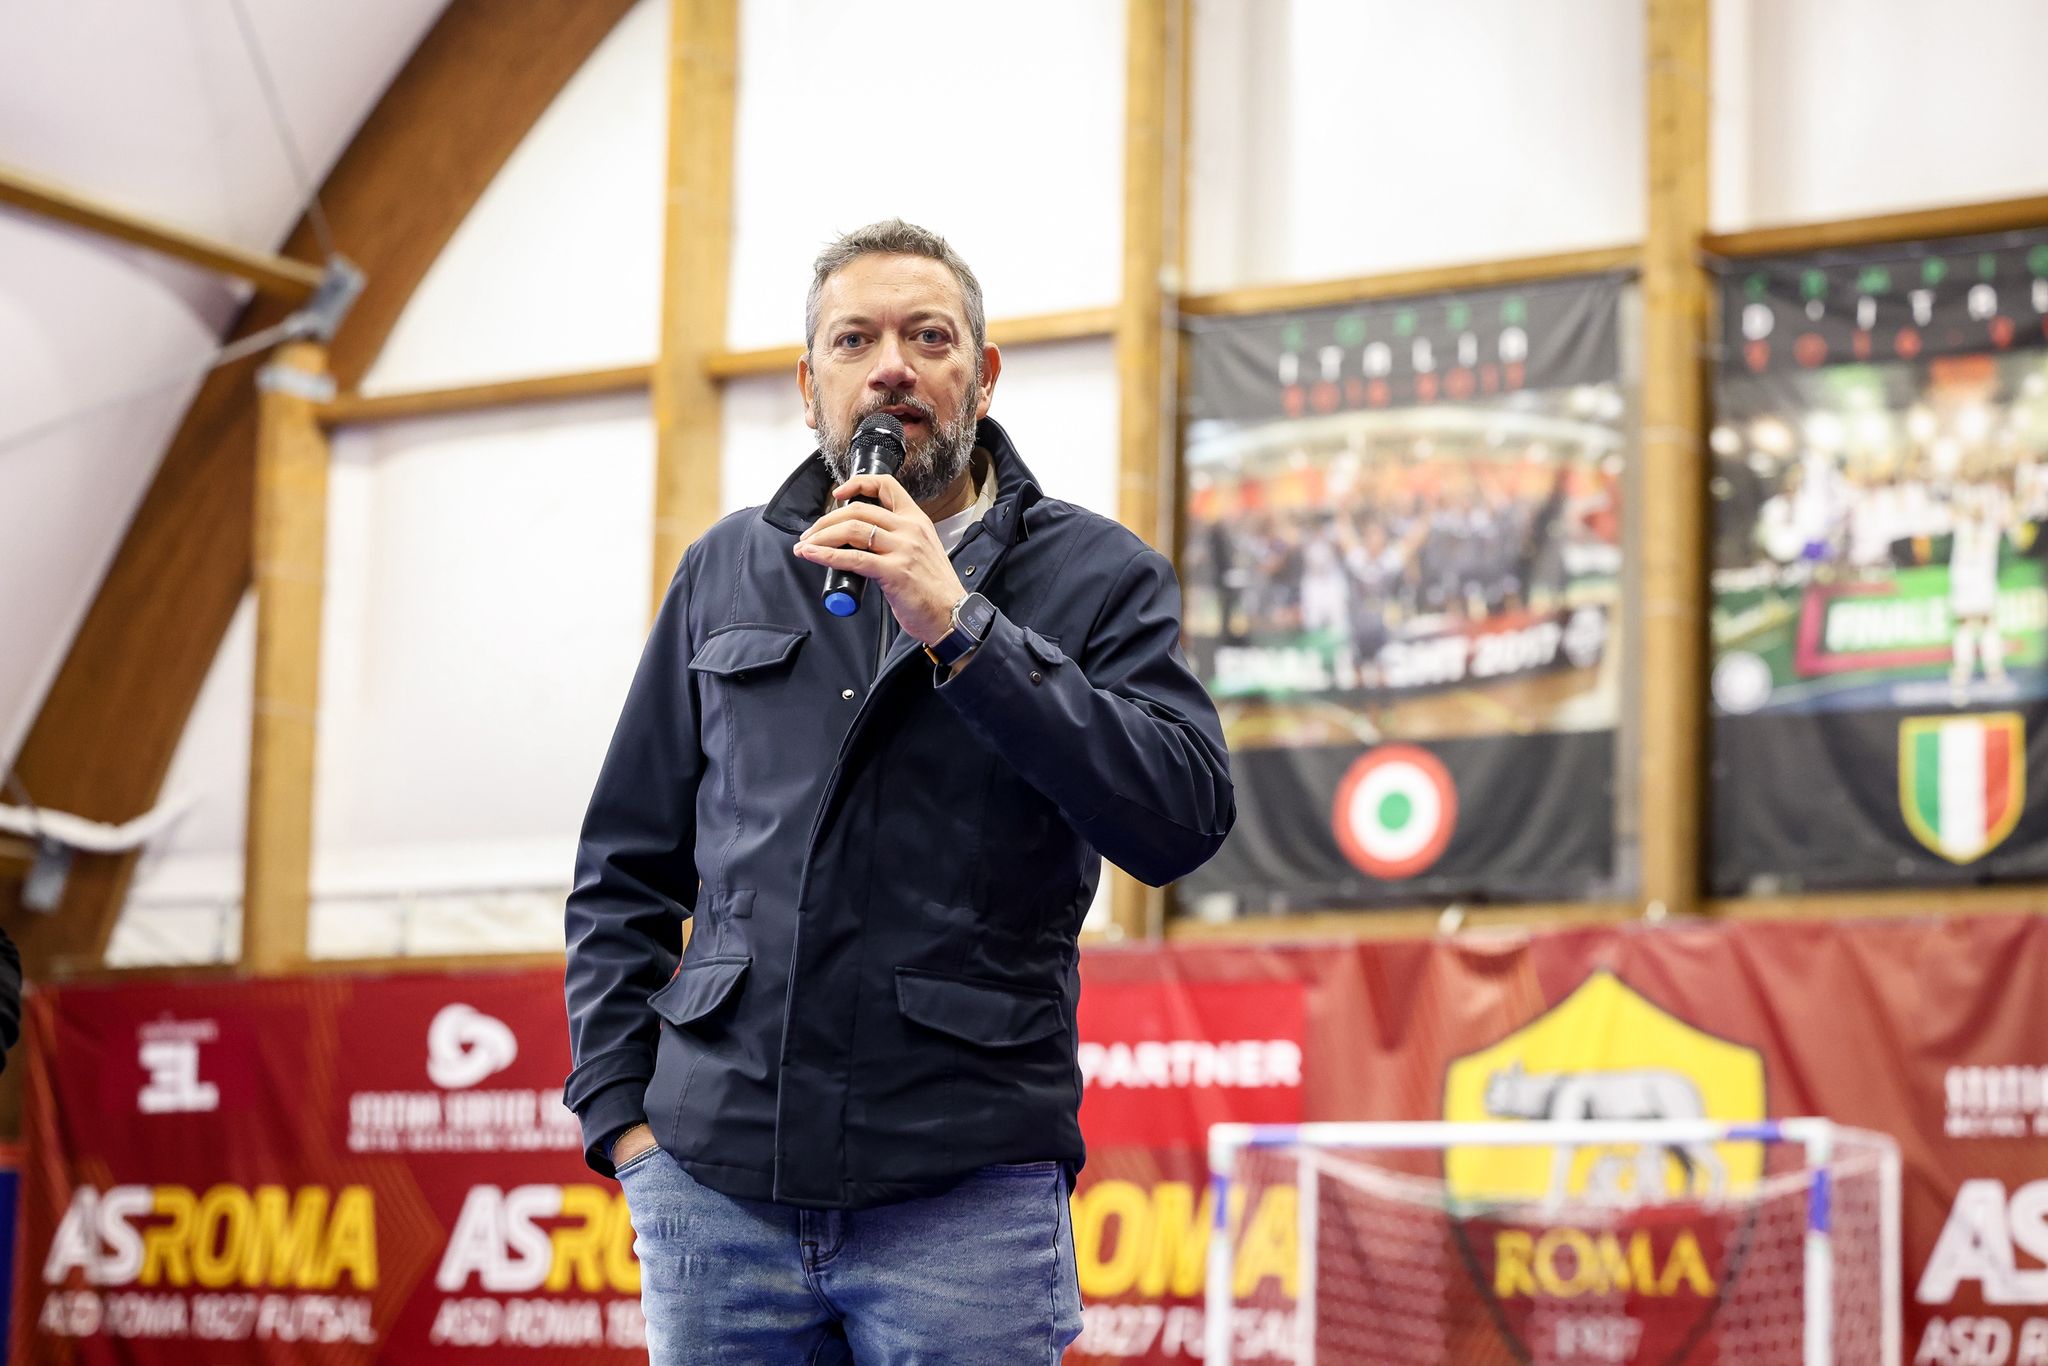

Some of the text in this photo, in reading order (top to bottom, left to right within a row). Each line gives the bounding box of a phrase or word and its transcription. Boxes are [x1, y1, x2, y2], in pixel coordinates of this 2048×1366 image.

[1079, 1040, 1302, 1088] PARTNER
[436, 1184, 641, 1293] ASR
[1494, 1227, 1718, 1300] ROMA
